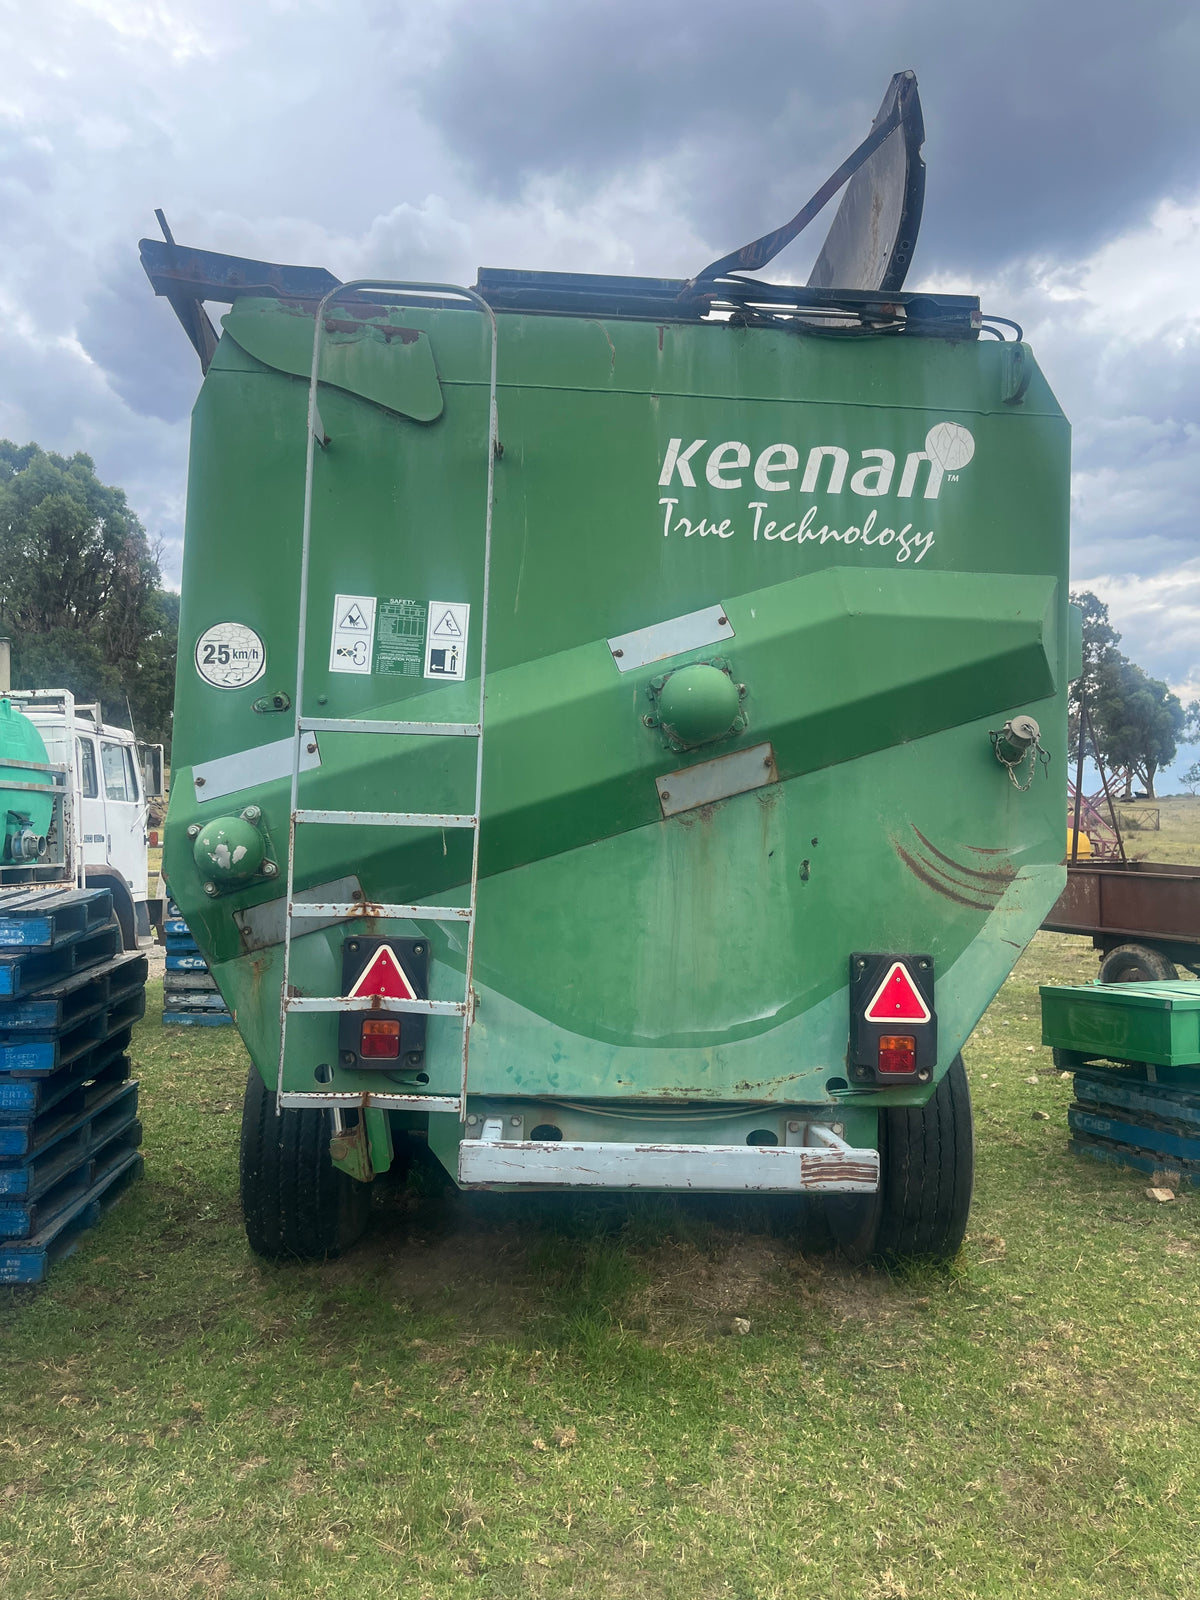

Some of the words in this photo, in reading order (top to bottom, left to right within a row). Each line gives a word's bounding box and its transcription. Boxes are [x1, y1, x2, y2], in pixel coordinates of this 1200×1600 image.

[658, 498, 734, 538] True
[748, 502, 935, 563] Technology
[203, 644, 230, 665] 25
[232, 648, 259, 660] km/h
